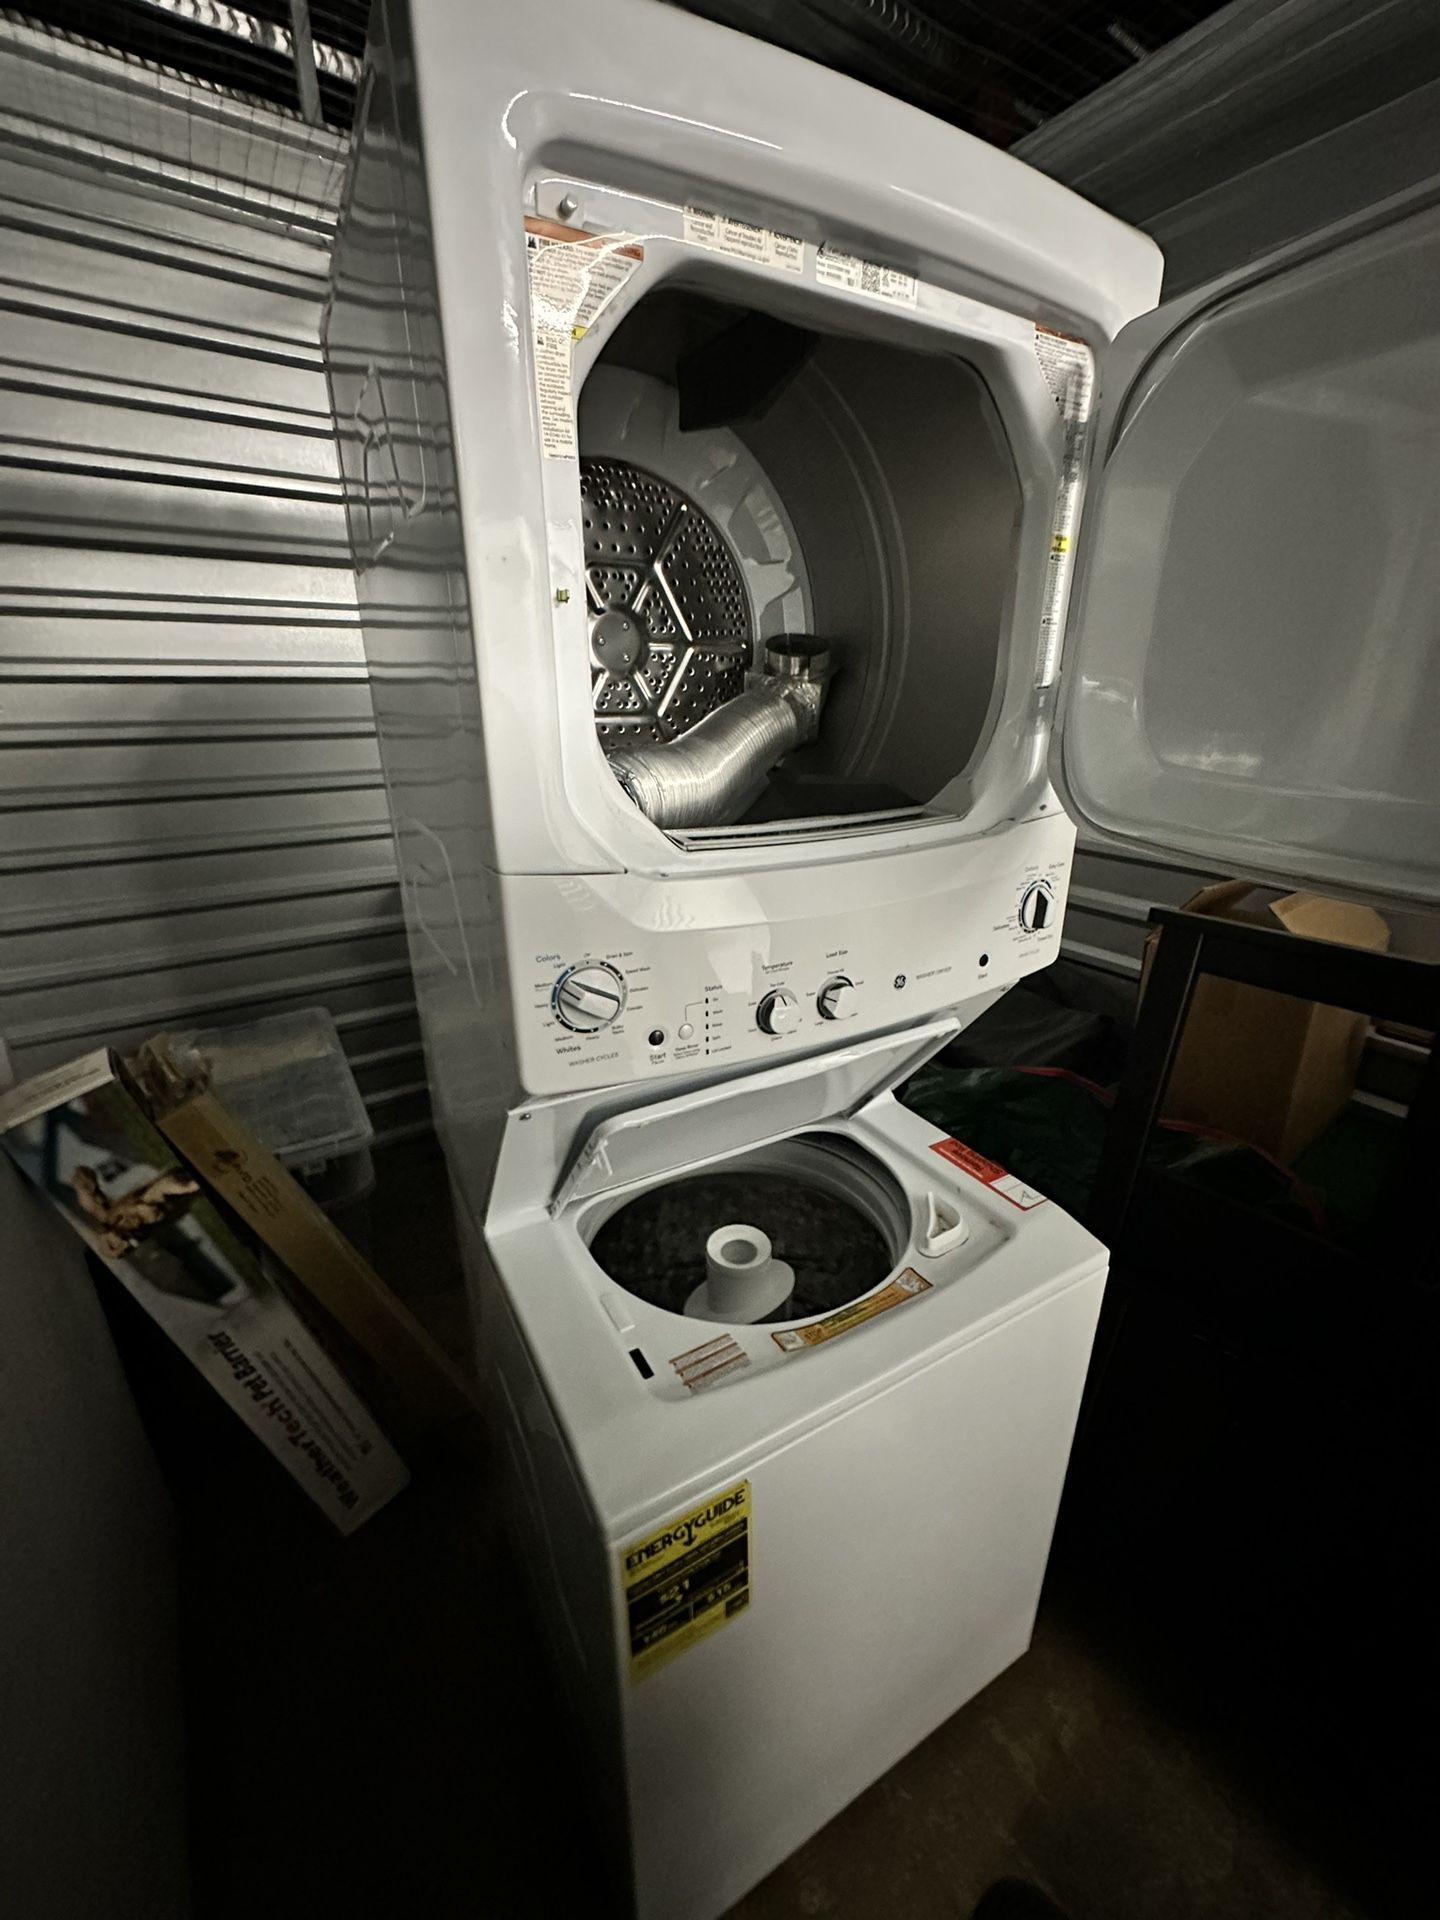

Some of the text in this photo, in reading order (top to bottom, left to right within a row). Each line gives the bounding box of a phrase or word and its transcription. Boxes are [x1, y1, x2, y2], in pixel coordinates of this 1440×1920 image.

[536, 954, 561, 963] Colors
[762, 961, 793, 971] Temperature
[704, 984, 723, 993] Status
[556, 1045, 581, 1055] Whites
[596, 1052, 619, 1063] CYCLES
[650, 1052, 666, 1061] Start
[208, 1331, 359, 1510] WeatherTech Pet Barrier
[626, 1489, 746, 1571] ENERGYGUIDE
